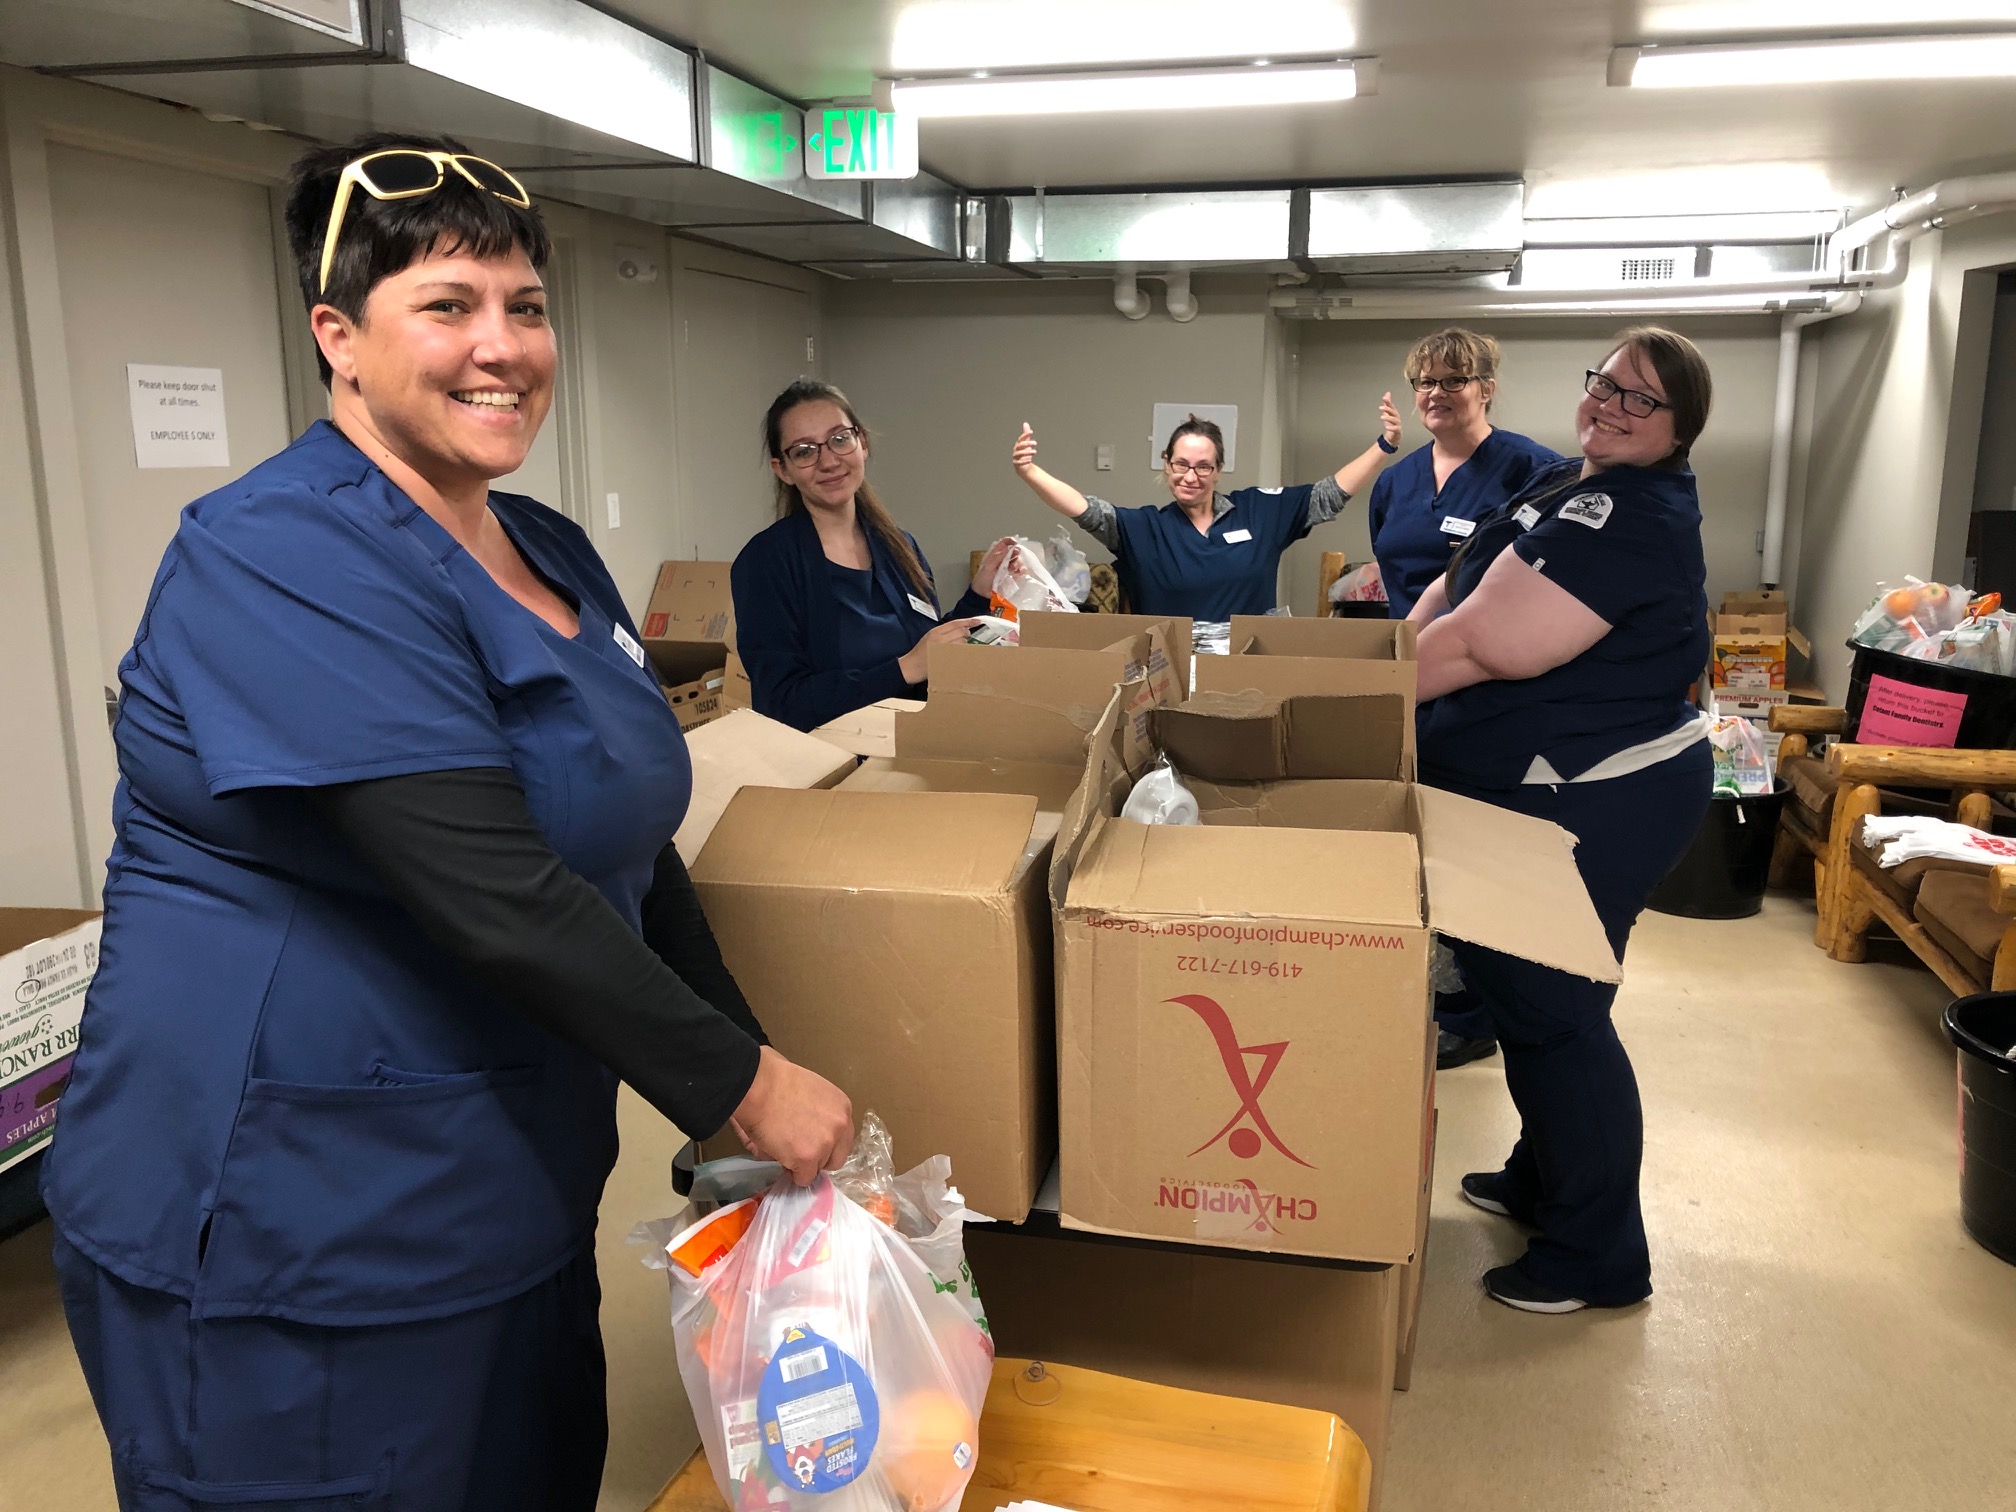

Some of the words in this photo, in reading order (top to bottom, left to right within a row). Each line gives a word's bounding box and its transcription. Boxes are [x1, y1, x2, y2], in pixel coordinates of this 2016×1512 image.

[823, 109, 896, 174] EXIT
[138, 379, 162, 390] Please
[163, 381, 180, 391] keep
[182, 382, 198, 391] door
[201, 382, 216, 392] shut
[160, 398, 166, 406] at
[168, 396, 177, 406] all
[196, 431, 216, 440] ONLY
[1714, 694, 1752, 703] PREMIUM
[1753, 696, 1784, 704] APPLES
[1878, 686, 1893, 696] After
[694, 698, 718, 716] 105824
[1878, 696, 1896, 706] return
[1896, 701, 1909, 710] this
[1910, 704, 1936, 716] bucket
[1890, 708, 1912, 722] Family
[1087, 915, 1405, 950] www.championfoodservice.com
[1176, 954, 1304, 978] 419-617-7122
[55, 1024, 80, 1050] RR
[0, 1039, 52, 1080] RANC
[6, 1113, 48, 1144] APPLES
[826, 1452, 858, 1474] FROSTED
[828, 1446, 854, 1466] FLAKES
